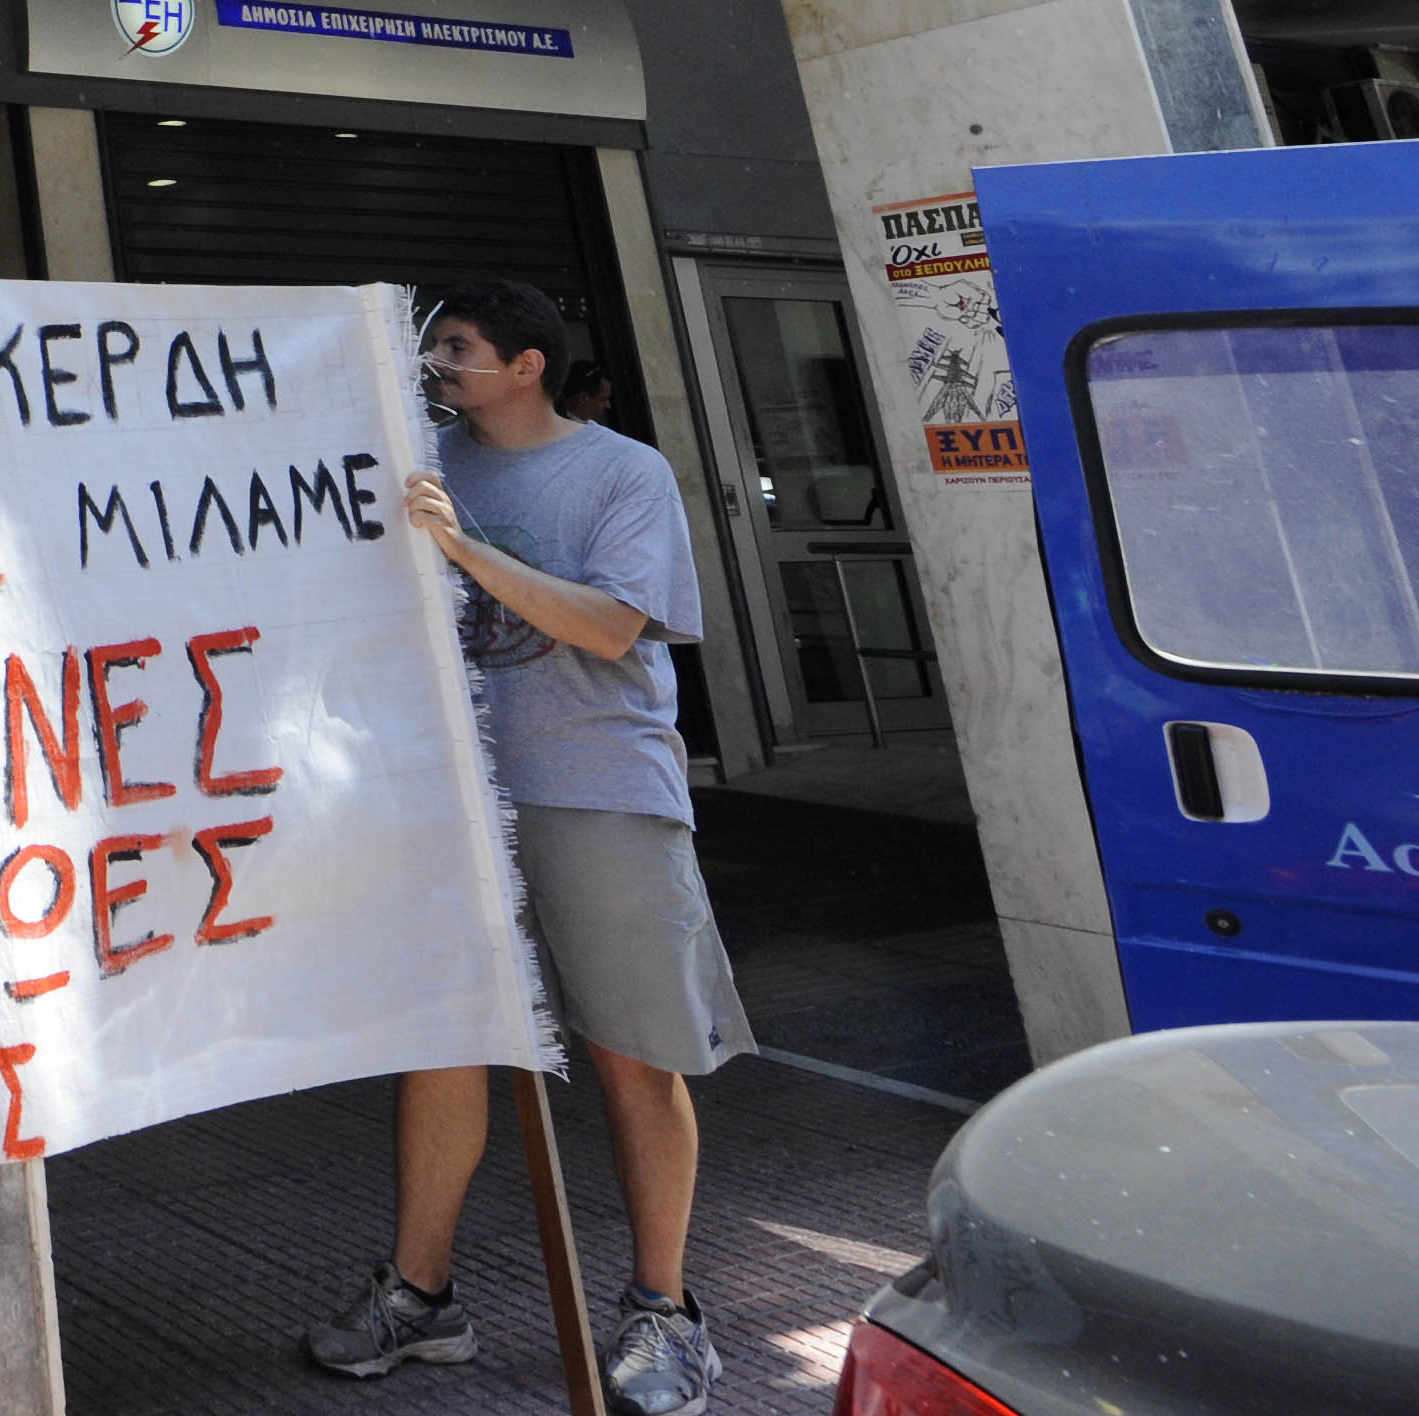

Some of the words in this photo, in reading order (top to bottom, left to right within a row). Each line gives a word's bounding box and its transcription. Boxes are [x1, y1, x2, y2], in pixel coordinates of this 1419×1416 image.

[241, 4, 316, 28] ΔΗΜΟΣΙΑ
[320, 12, 416, 38] ΕΠΙΧΕΙΡΗΣΗ
[421, 22, 527, 48] ΗΛΕΚΤΡΙΣΜΟΥ
[532, 32, 560, 51] Α.Ε.
[881, 202, 983, 240] ΠΑΣΠΑ
[935, 428, 1023, 452] ΞΥΠ
[954, 454, 1012, 467] ΜΗΤΕΡΑ
[78, 452, 386, 570] ΜΙΛΑΜΕ
